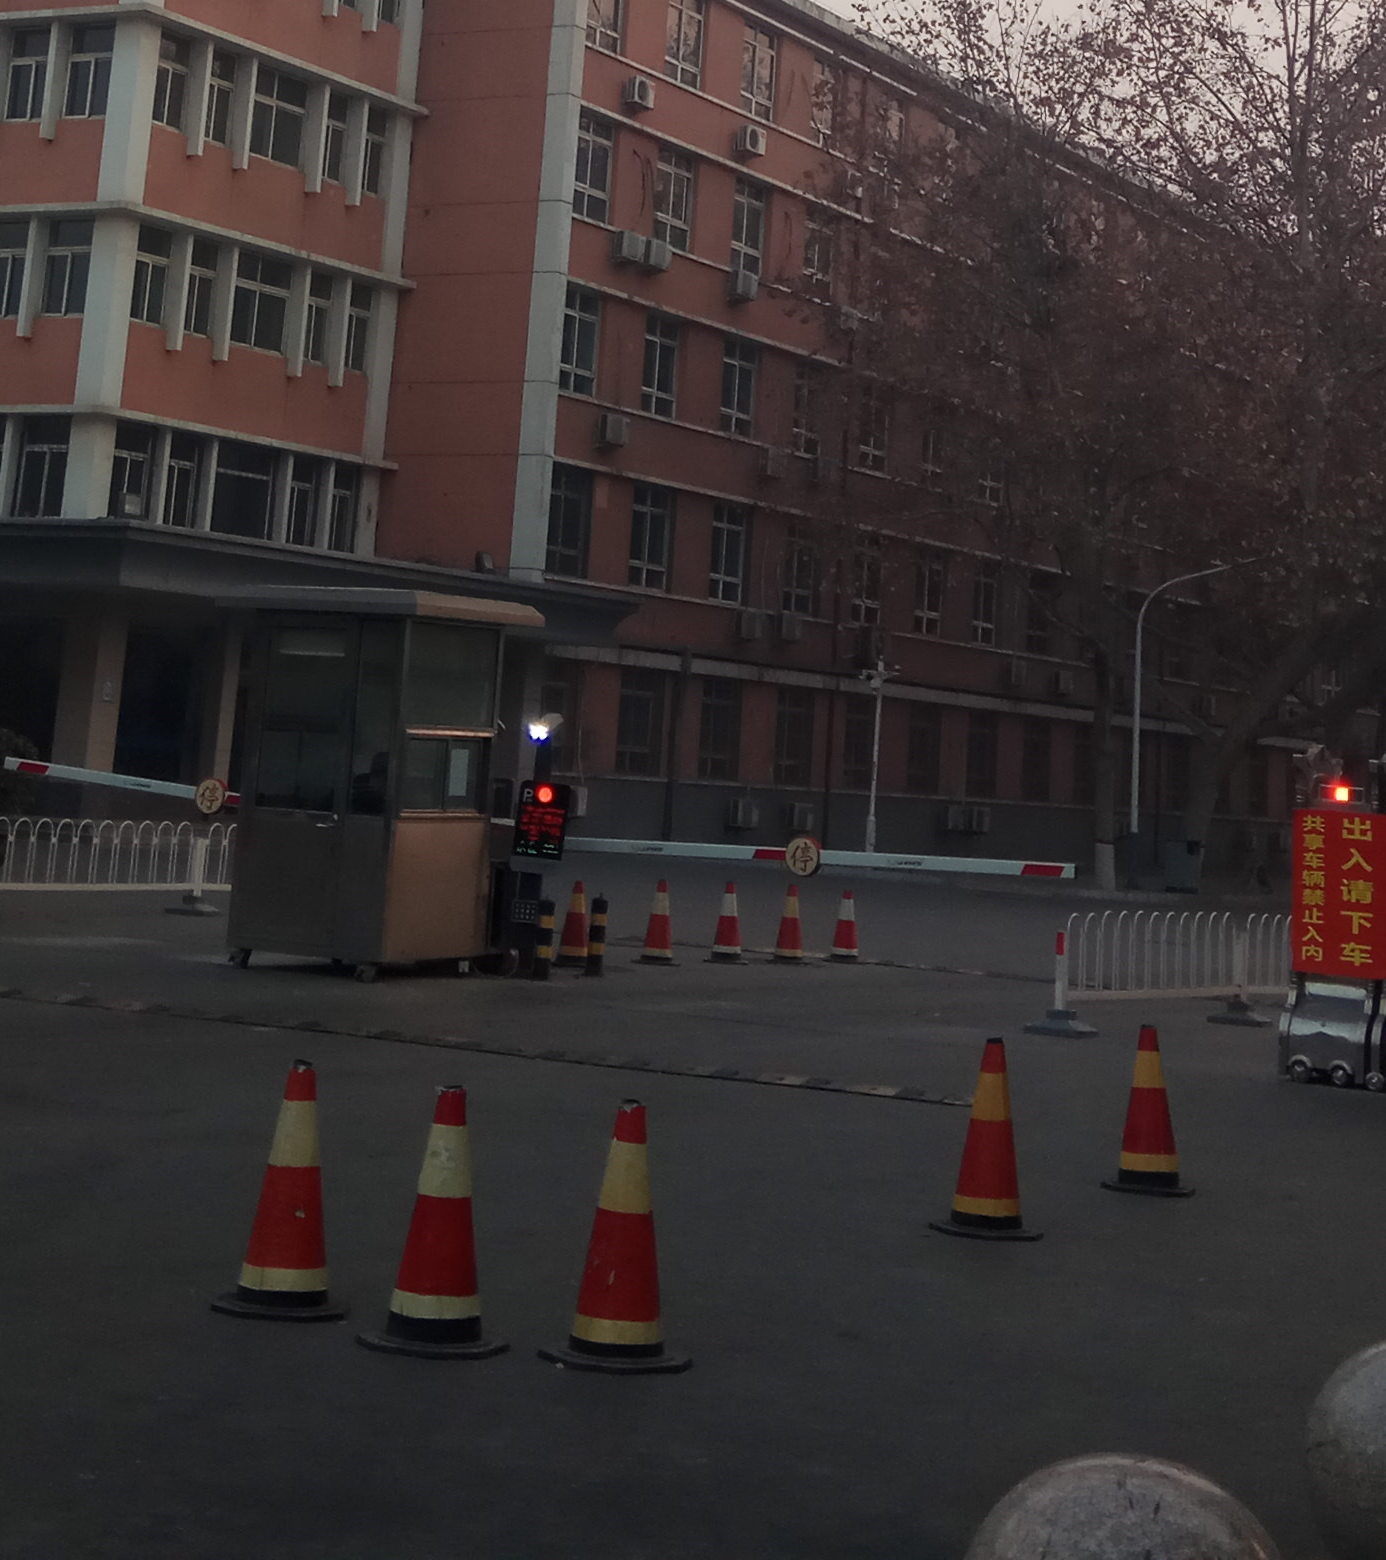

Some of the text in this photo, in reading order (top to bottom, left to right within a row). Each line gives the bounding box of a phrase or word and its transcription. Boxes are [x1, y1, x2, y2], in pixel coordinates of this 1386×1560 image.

[790, 841, 814, 873] 停
[1302, 815, 1325, 962] 共享车辆禁止入内
[1339, 816, 1373, 967] 出入请下车
